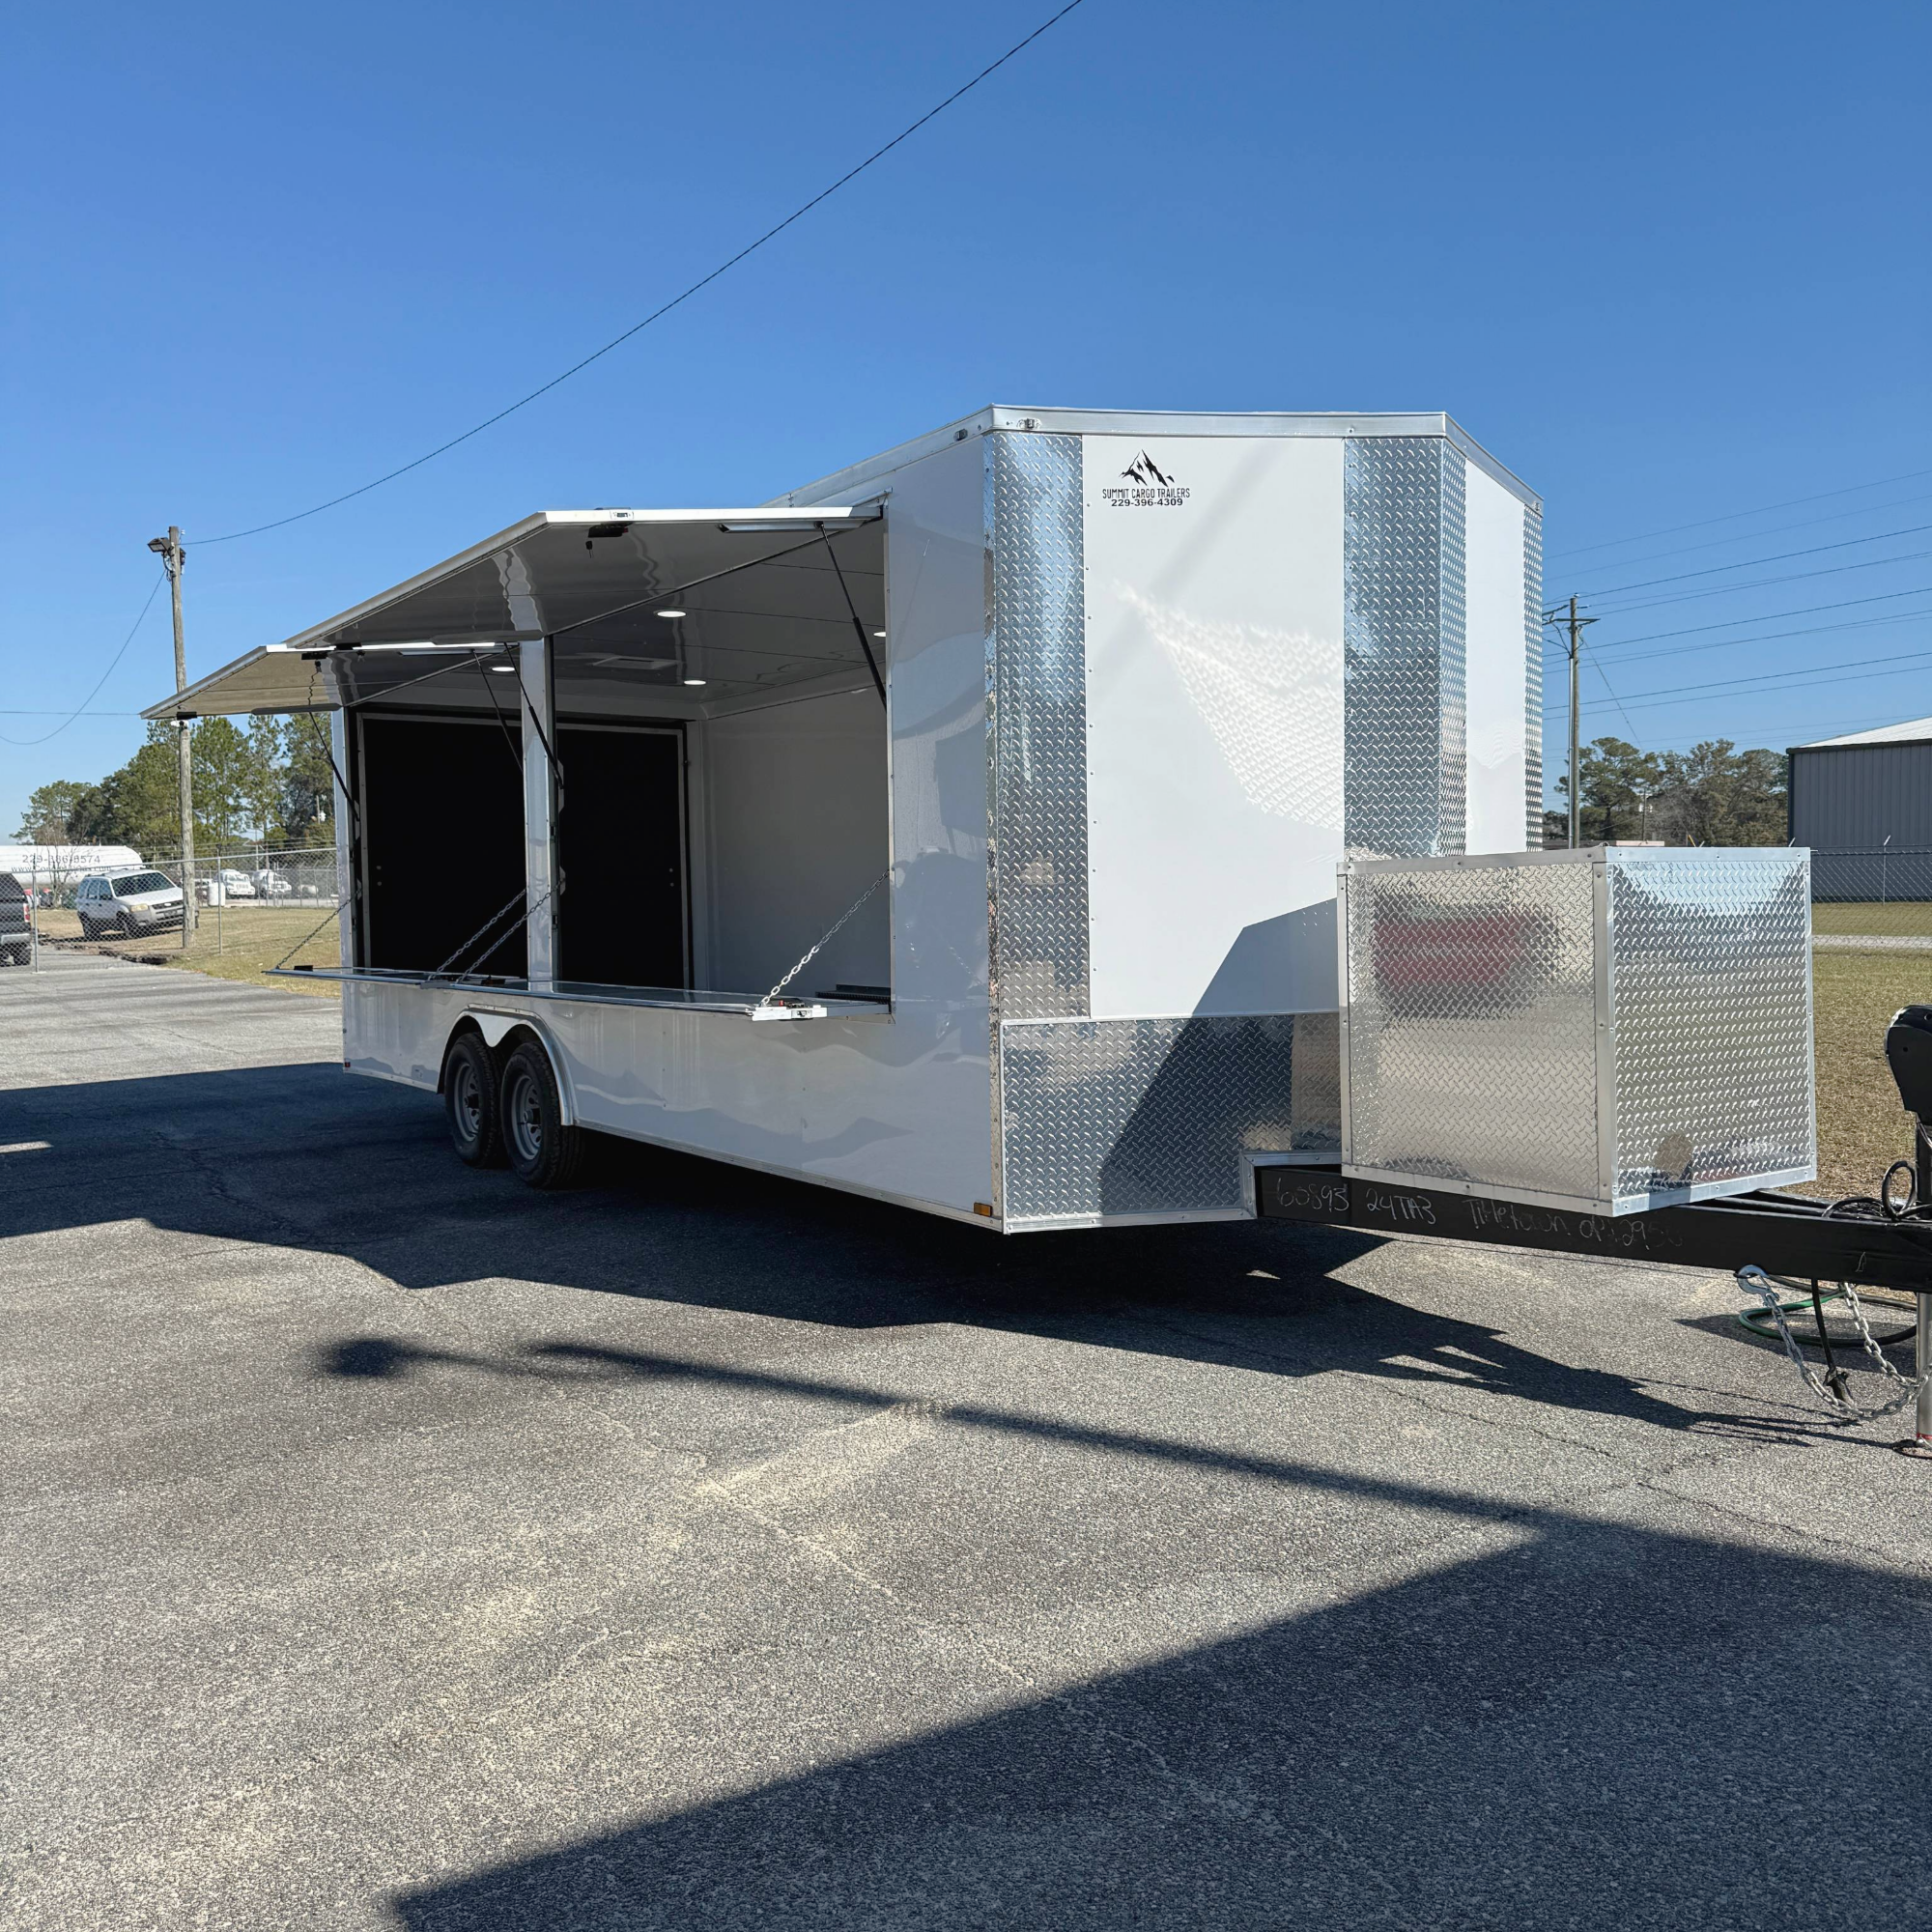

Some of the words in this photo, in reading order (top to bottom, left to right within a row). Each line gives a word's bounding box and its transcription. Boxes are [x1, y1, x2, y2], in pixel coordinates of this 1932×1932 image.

[1102, 488, 1129, 498] SUMMIT
[1131, 488, 1155, 498] CARGO
[1157, 488, 1190, 498] TRAILERS
[1111, 498, 1183, 507] 229-396-4309
